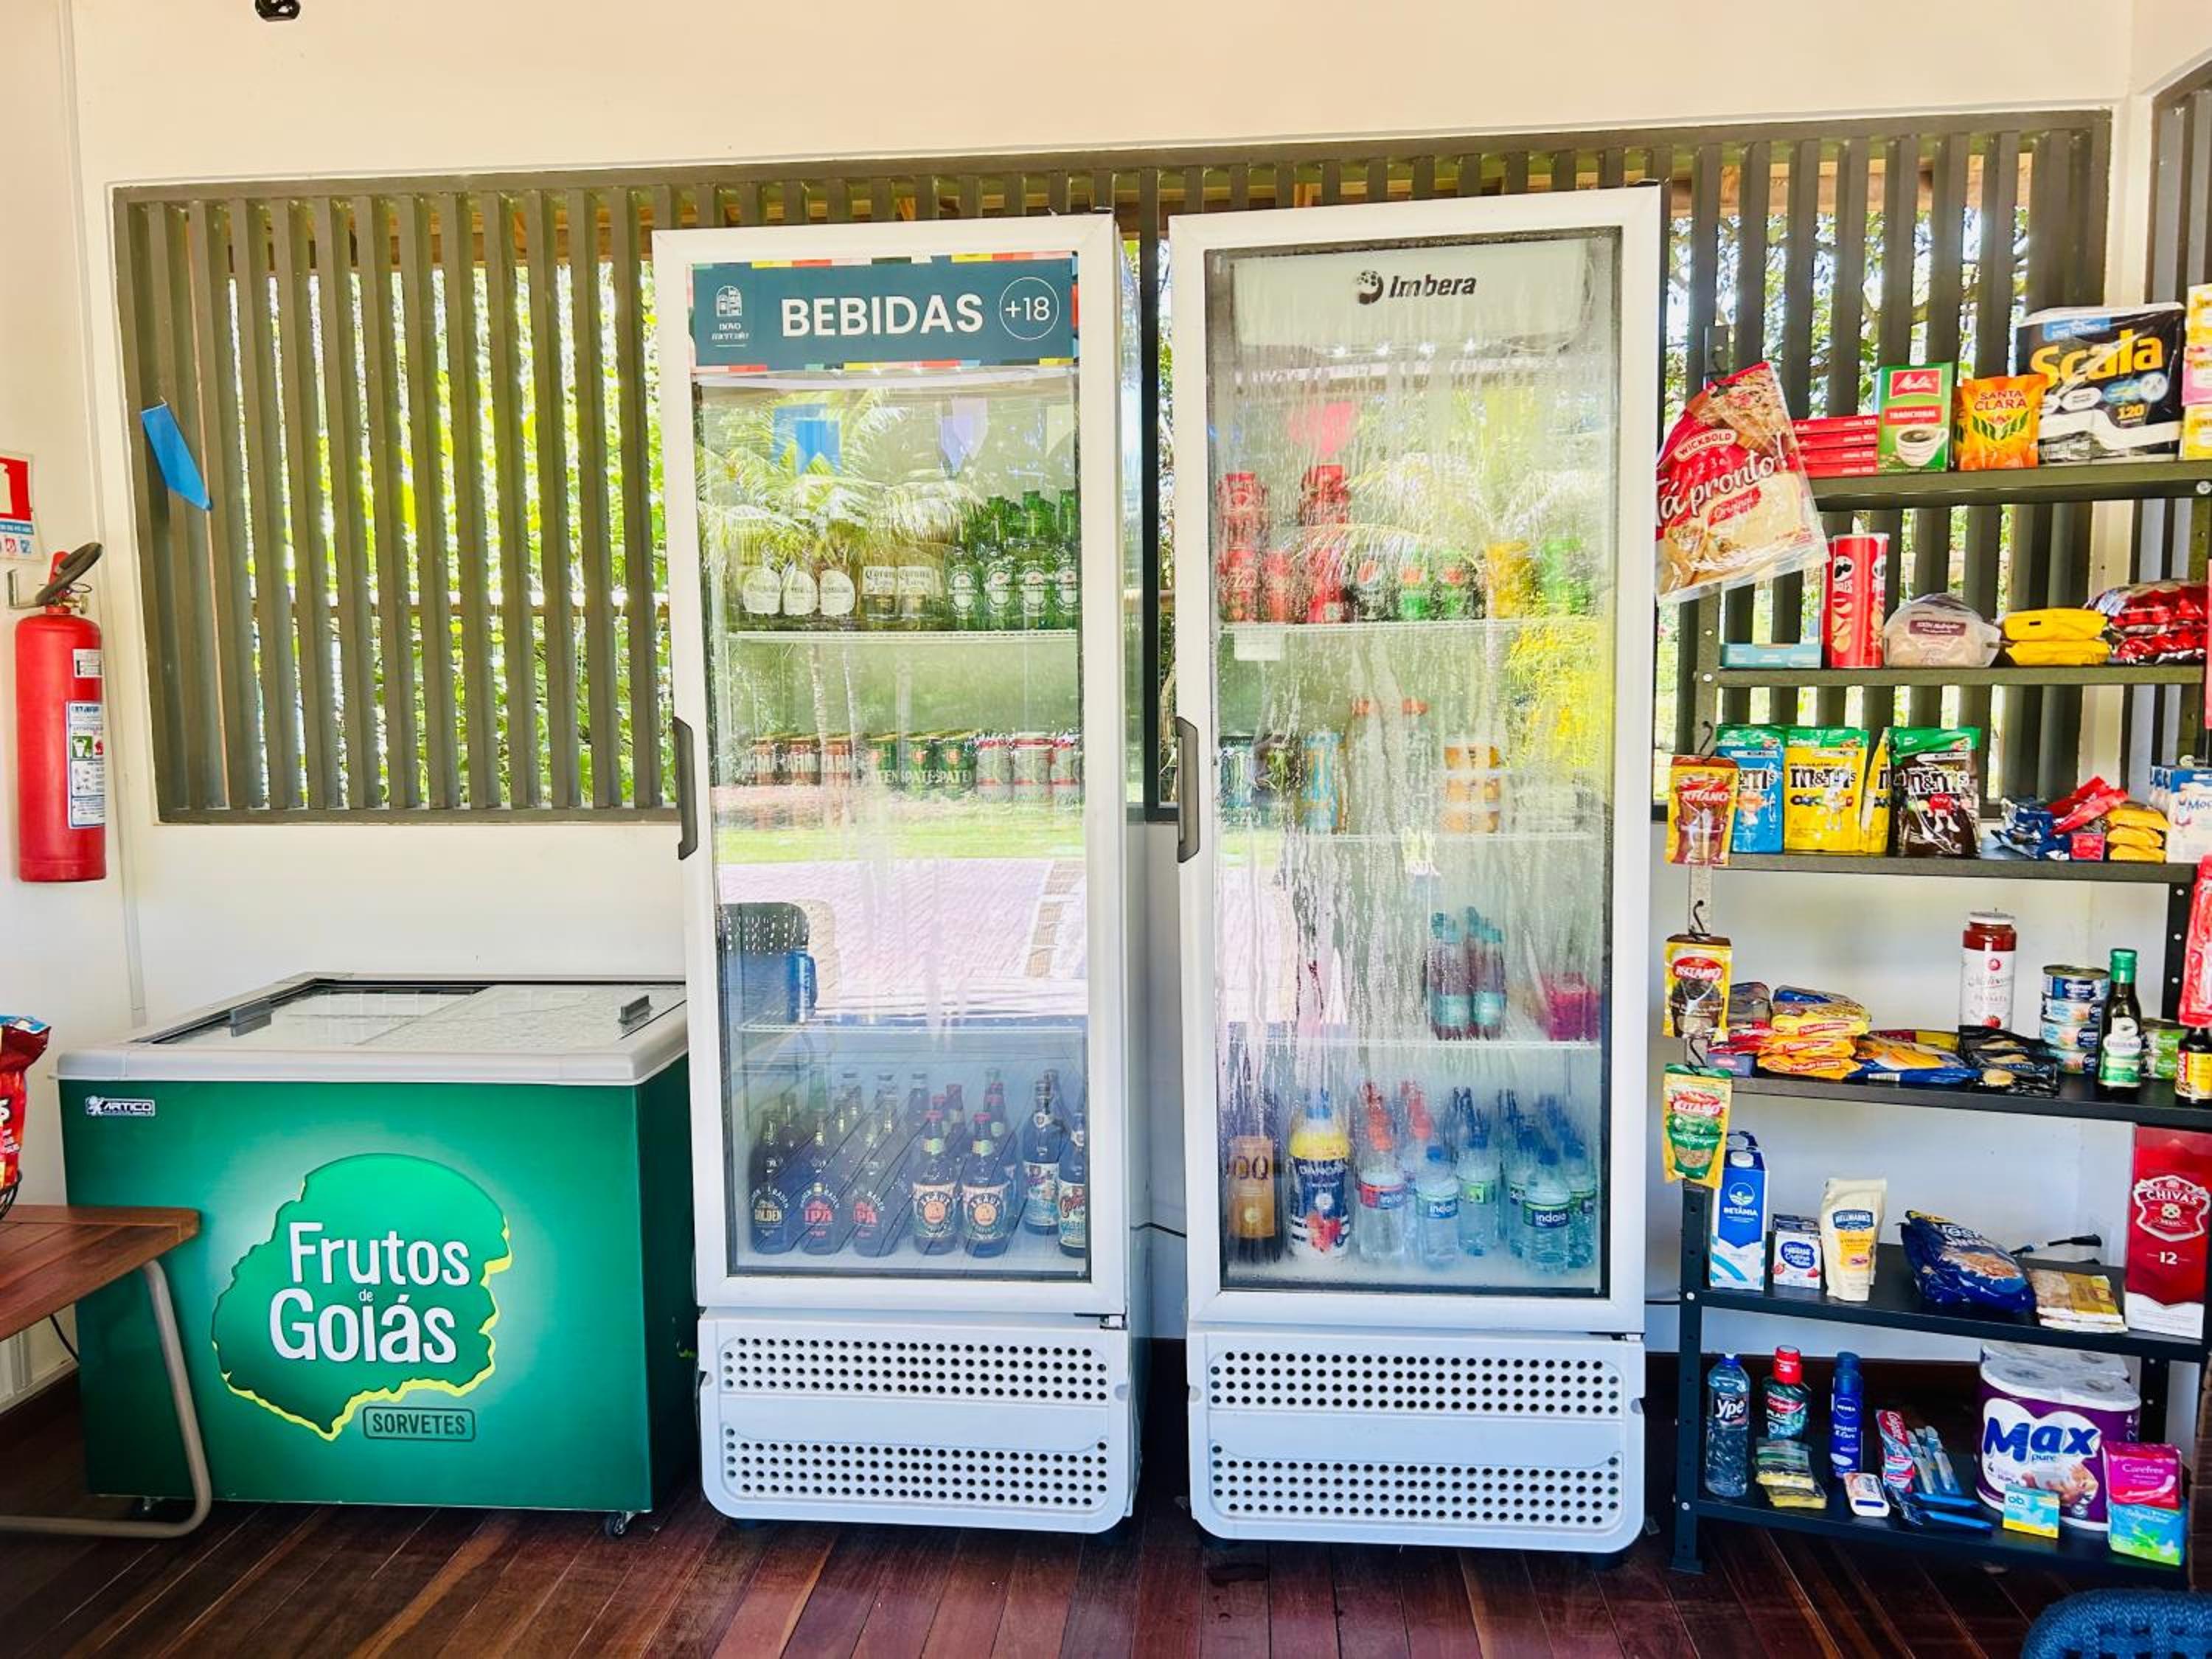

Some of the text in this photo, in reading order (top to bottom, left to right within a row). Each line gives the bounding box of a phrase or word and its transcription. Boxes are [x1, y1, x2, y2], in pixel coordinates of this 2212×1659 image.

[1388, 274, 1477, 298] Imbera
[781, 293, 983, 338] BEBIDAS
[1005, 296, 1051, 322] +18
[2030, 329, 2163, 389] Scala
[1974, 397, 2028, 411] CLARA
[1980, 389, 2023, 400] SANTA
[2117, 403, 2145, 420] 120
[1679, 432, 1732, 456] WICKBOLD
[1688, 429, 1788, 516] pronto!
[2146, 1189, 2199, 1206] CHIVAS
[288, 1221, 470, 1286] Frutos
[2159, 1251, 2177, 1265] 12
[358, 1288, 374, 1302] de
[269, 1288, 457, 1364] Goiás
[372, 1413, 466, 1436] SORVETES
[1983, 1416, 2101, 1462] Max
[2121, 1463, 2165, 1475] Carefree
